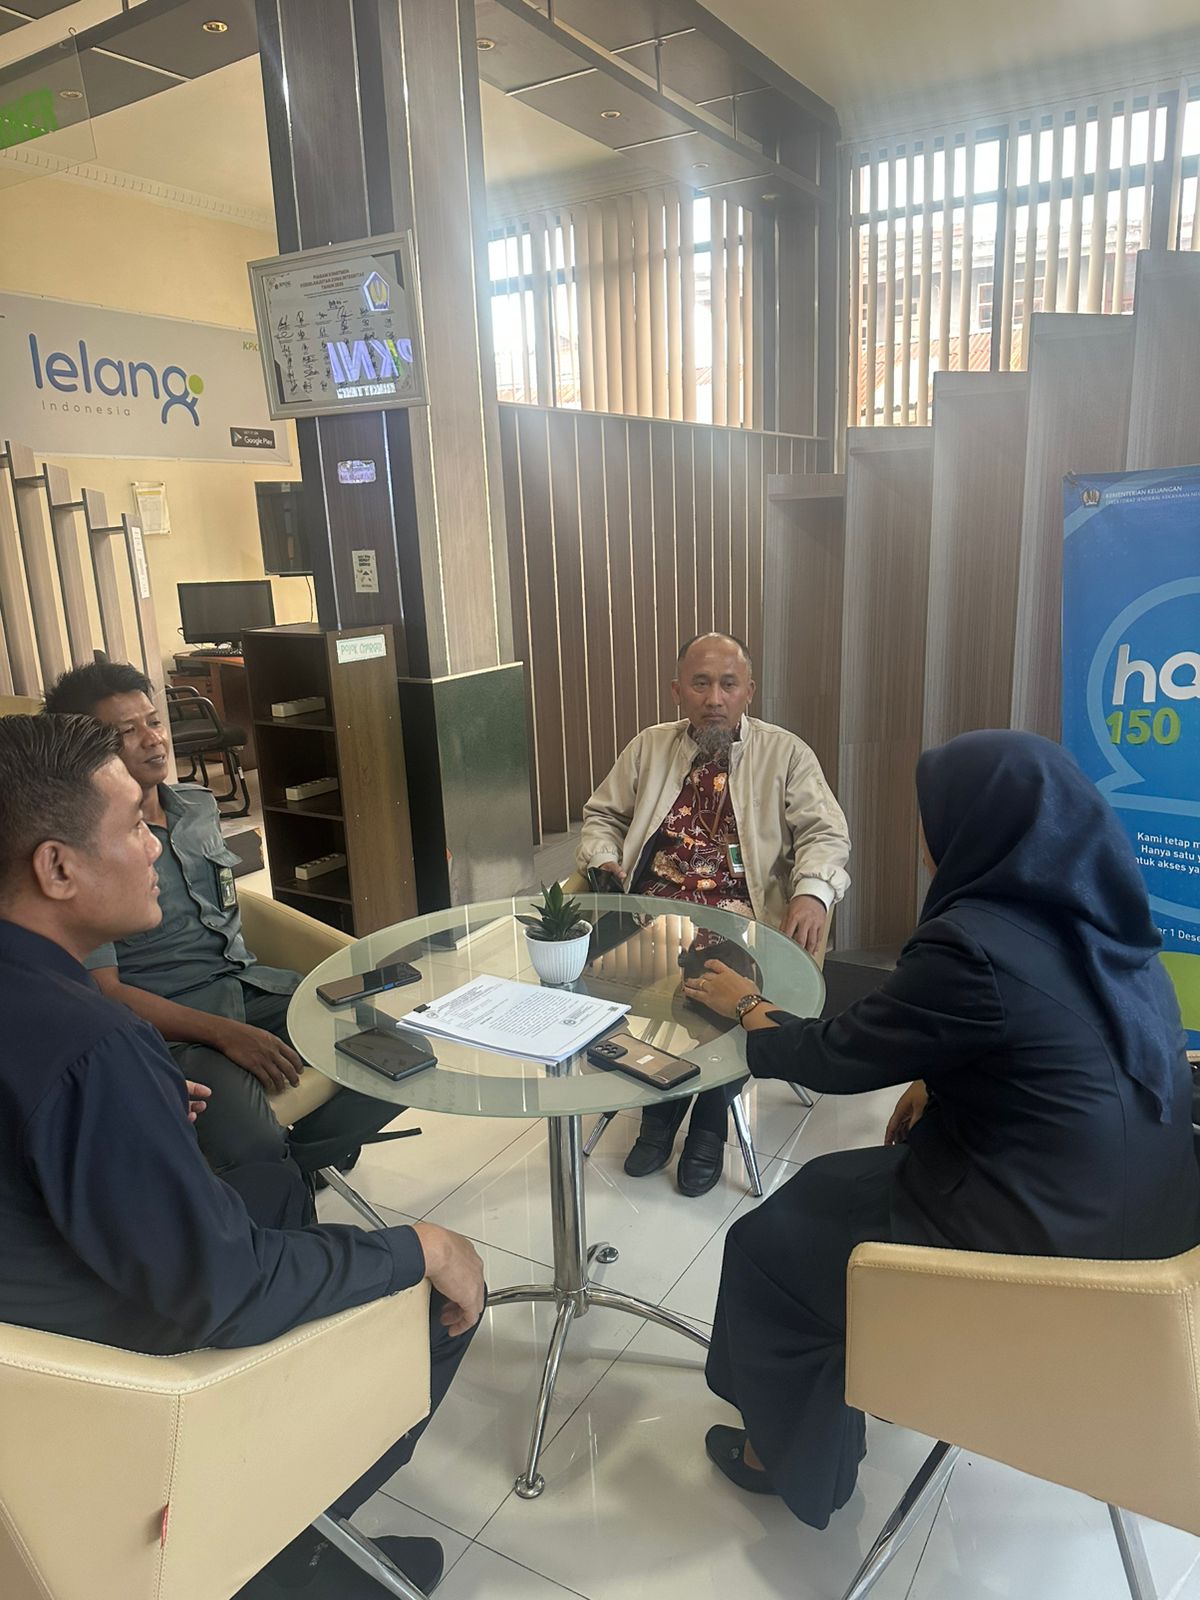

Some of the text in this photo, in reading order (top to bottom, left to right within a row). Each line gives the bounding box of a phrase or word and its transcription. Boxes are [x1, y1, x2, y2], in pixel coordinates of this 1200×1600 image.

[28, 333, 204, 427] lelang
[42, 401, 132, 416] Indonesia
[244, 435, 273, 447] Google Play
[1147, 486, 1183, 495] KEUANGAN
[1106, 707, 1181, 746] 150
[1137, 831, 1162, 843] Kami
[1164, 836, 1190, 849] tetap
[1141, 844, 1171, 857] Hanya
[1173, 850, 1195, 861] satu
[1157, 860, 1187, 872] akses
[1170, 928, 1175, 937] 1
